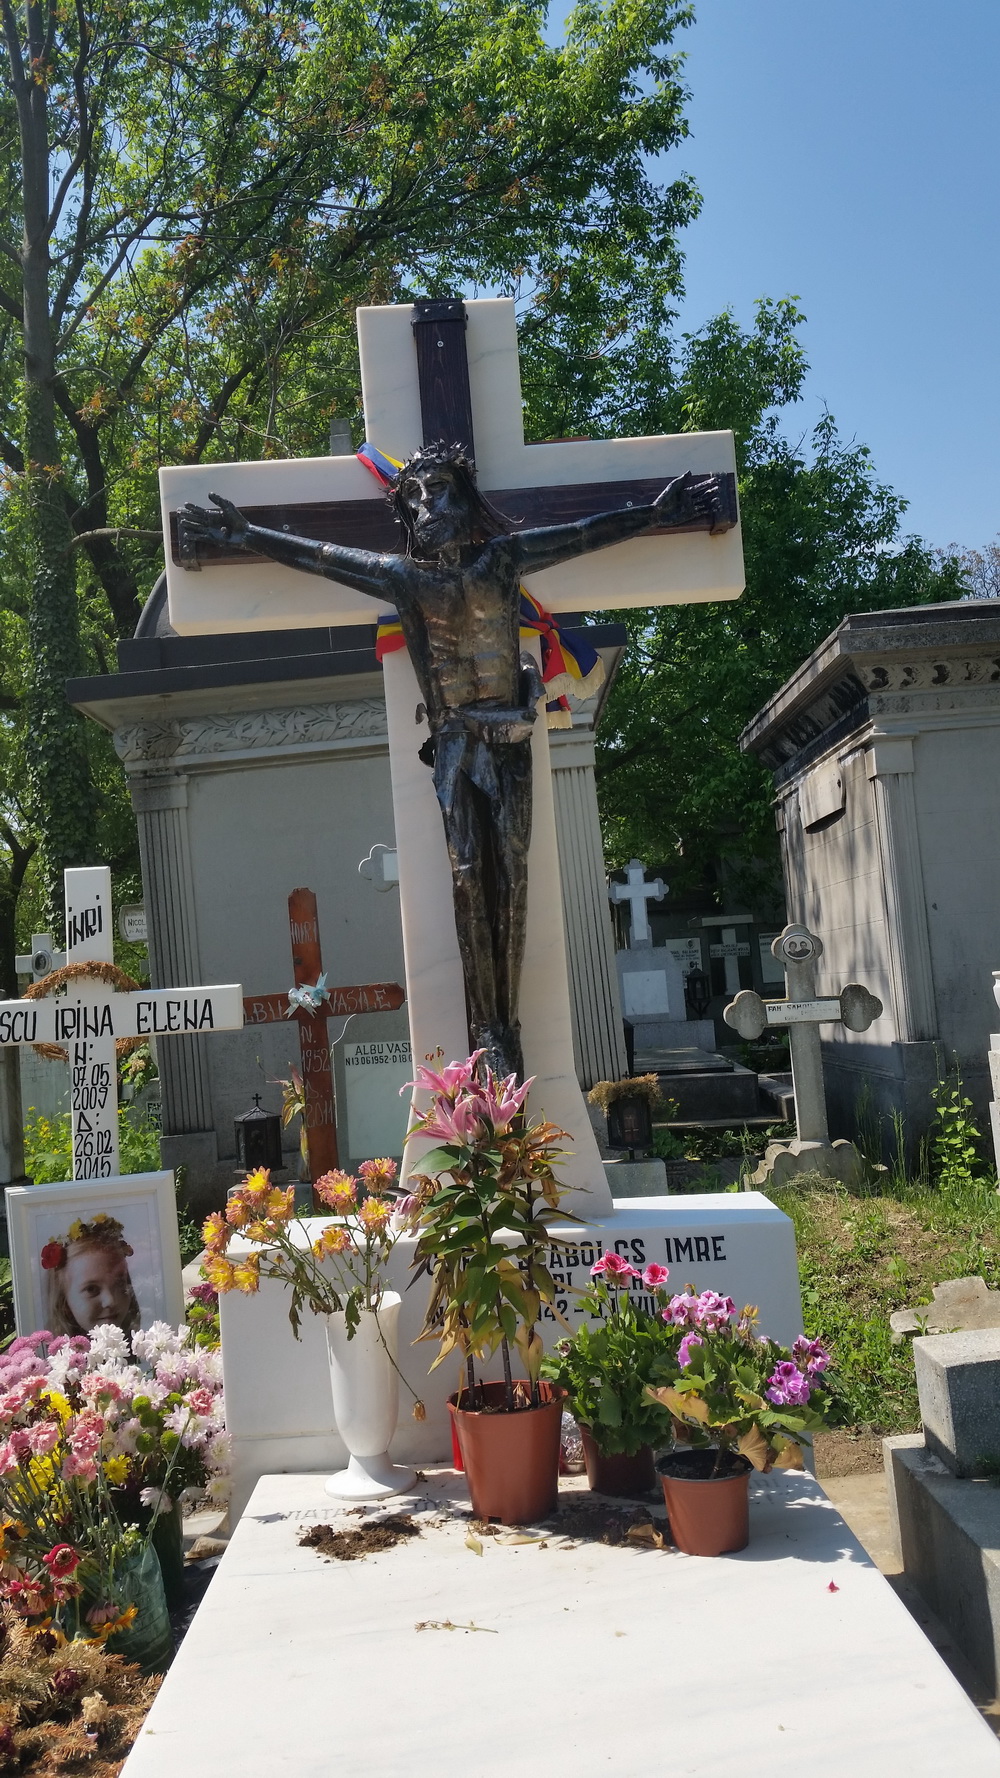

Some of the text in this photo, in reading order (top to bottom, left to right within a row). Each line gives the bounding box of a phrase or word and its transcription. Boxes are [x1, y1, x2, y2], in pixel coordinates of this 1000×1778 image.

[137, 999, 214, 1035] ELENA
[243, 1000, 283, 1023] LBU
[302, 1047, 331, 1073] 1952
[355, 1043, 384, 1056] ALBU
[73, 1063, 112, 1088] 07.05.
[73, 1087, 109, 1111] 2009
[75, 1129, 115, 1158] 26.02.
[75, 1156, 111, 1180] 2015
[664, 1236, 727, 1263] IMRE
